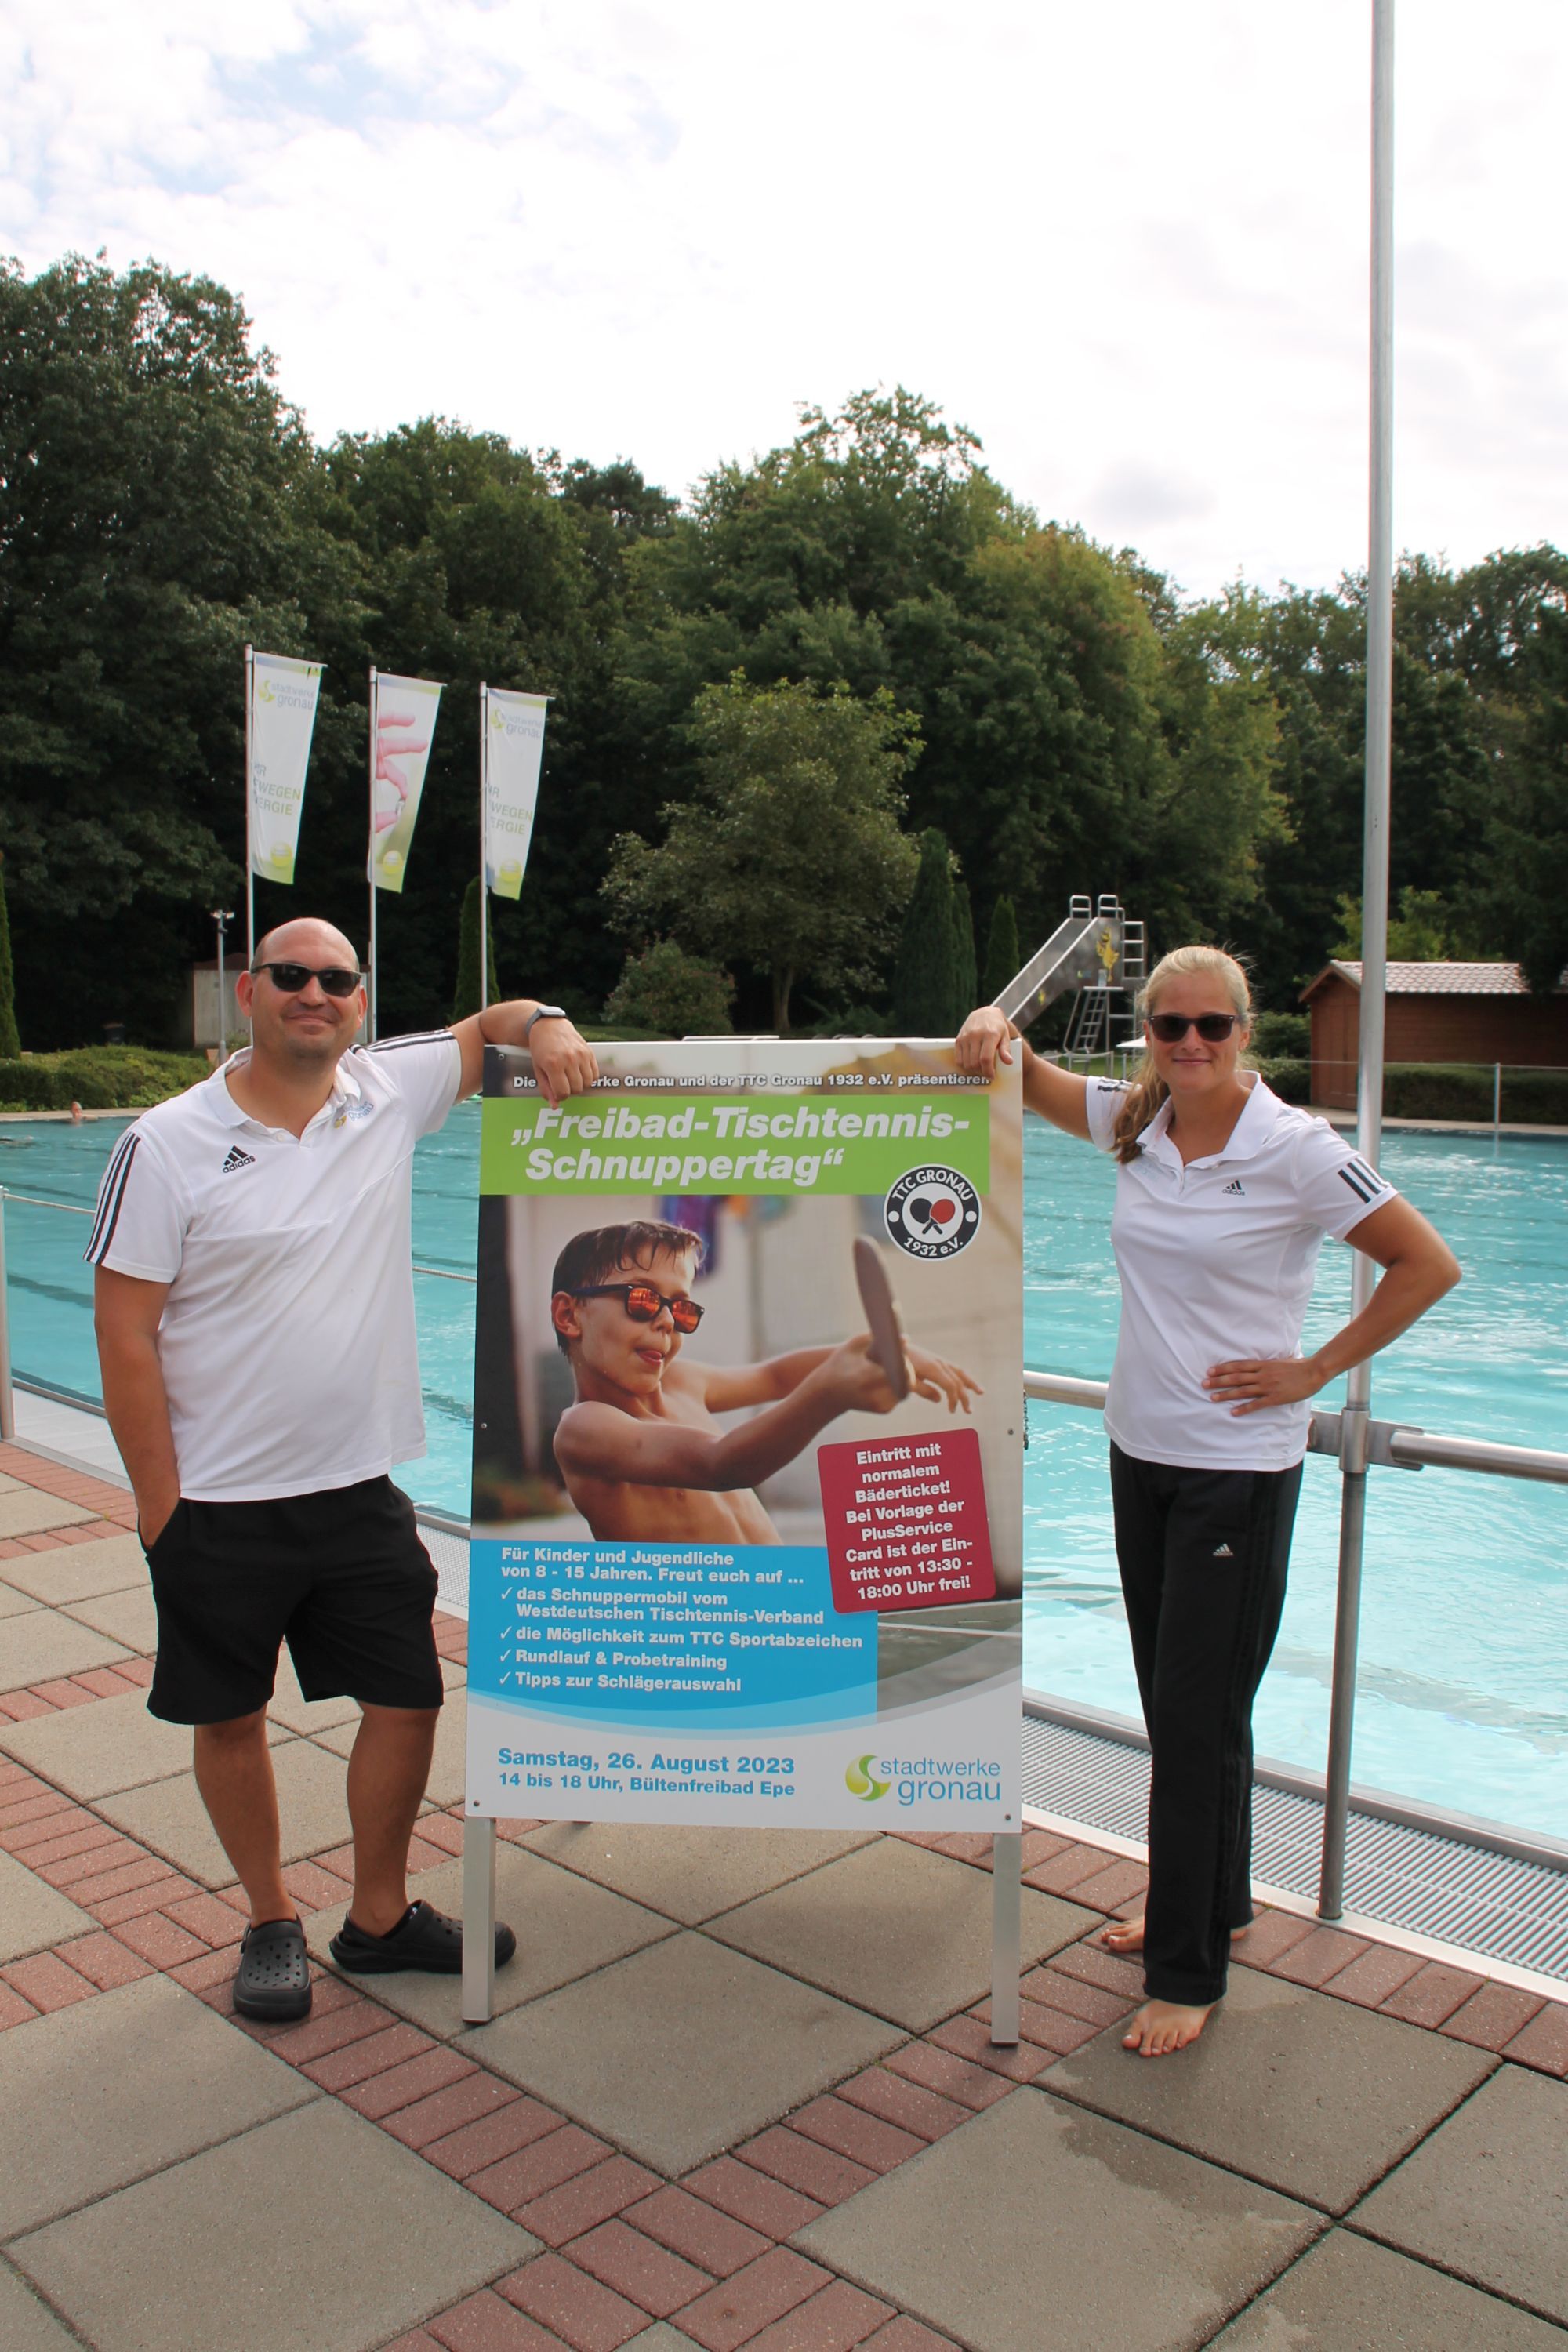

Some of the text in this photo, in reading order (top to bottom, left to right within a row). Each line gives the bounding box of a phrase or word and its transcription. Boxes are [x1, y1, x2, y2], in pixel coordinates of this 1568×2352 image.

[277, 694, 314, 710] gronau
[490, 800, 533, 822] WEGEN
[514, 1076, 536, 1087] Die
[624, 1075, 674, 1087] Gronau
[679, 1075, 705, 1087] und
[710, 1075, 735, 1087] der
[739, 1074, 767, 1086] TTC
[771, 1074, 822, 1086] Gronau
[828, 1073, 863, 1086] 1932
[868, 1074, 893, 1085] e.V.
[898, 1073, 989, 1087] präsentieren
[223, 1155, 256, 1173] adidas
[891, 1169, 974, 1201] TTC GRONAU
[903, 1236, 964, 1257] 1932 e.V.
[856, 1443, 942, 1465] Eintritt mit
[862, 1465, 940, 1483] normalem
[855, 1480, 950, 1504] Bäderticket!
[846, 1500, 965, 1524] Bei Vorlage der
[861, 1521, 953, 1542] PlusService
[502, 1547, 735, 1566] Für Kinder und Jugendliche
[845, 1537, 973, 1563] Card ist der Ein-
[501, 1566, 530, 1577] von
[535, 1565, 546, 1577] 8
[565, 1566, 585, 1578] 15
[590, 1566, 653, 1581] Jahren.
[659, 1568, 703, 1581] Freut
[708, 1570, 750, 1583] euch
[755, 1570, 783, 1584] auf
[849, 1566, 880, 1581] tritt
[884, 1565, 913, 1577] von
[917, 1557, 962, 1574] 13:30
[517, 1587, 728, 1605] das Schnuppermobil vom
[858, 1575, 971, 1600] 18:00 Uhr frei!
[516, 1603, 824, 1624] Westdeutschen Tischtennis-Verband
[516, 1627, 863, 1648] die Möglichkeit zum TTC Sportabzeichen
[516, 1649, 728, 1671] Rundlauf & Probetraining
[515, 1671, 741, 1692] Tipps zur Schlägerauswahl
[498, 1748, 794, 1775] Samstag, 26. August 2023
[880, 1757, 1000, 1776] stadtwerke
[499, 1773, 795, 1798] 14 bis 18 Uhr, Bültenfreibad Epe
[898, 1780, 1000, 1806] gronau
